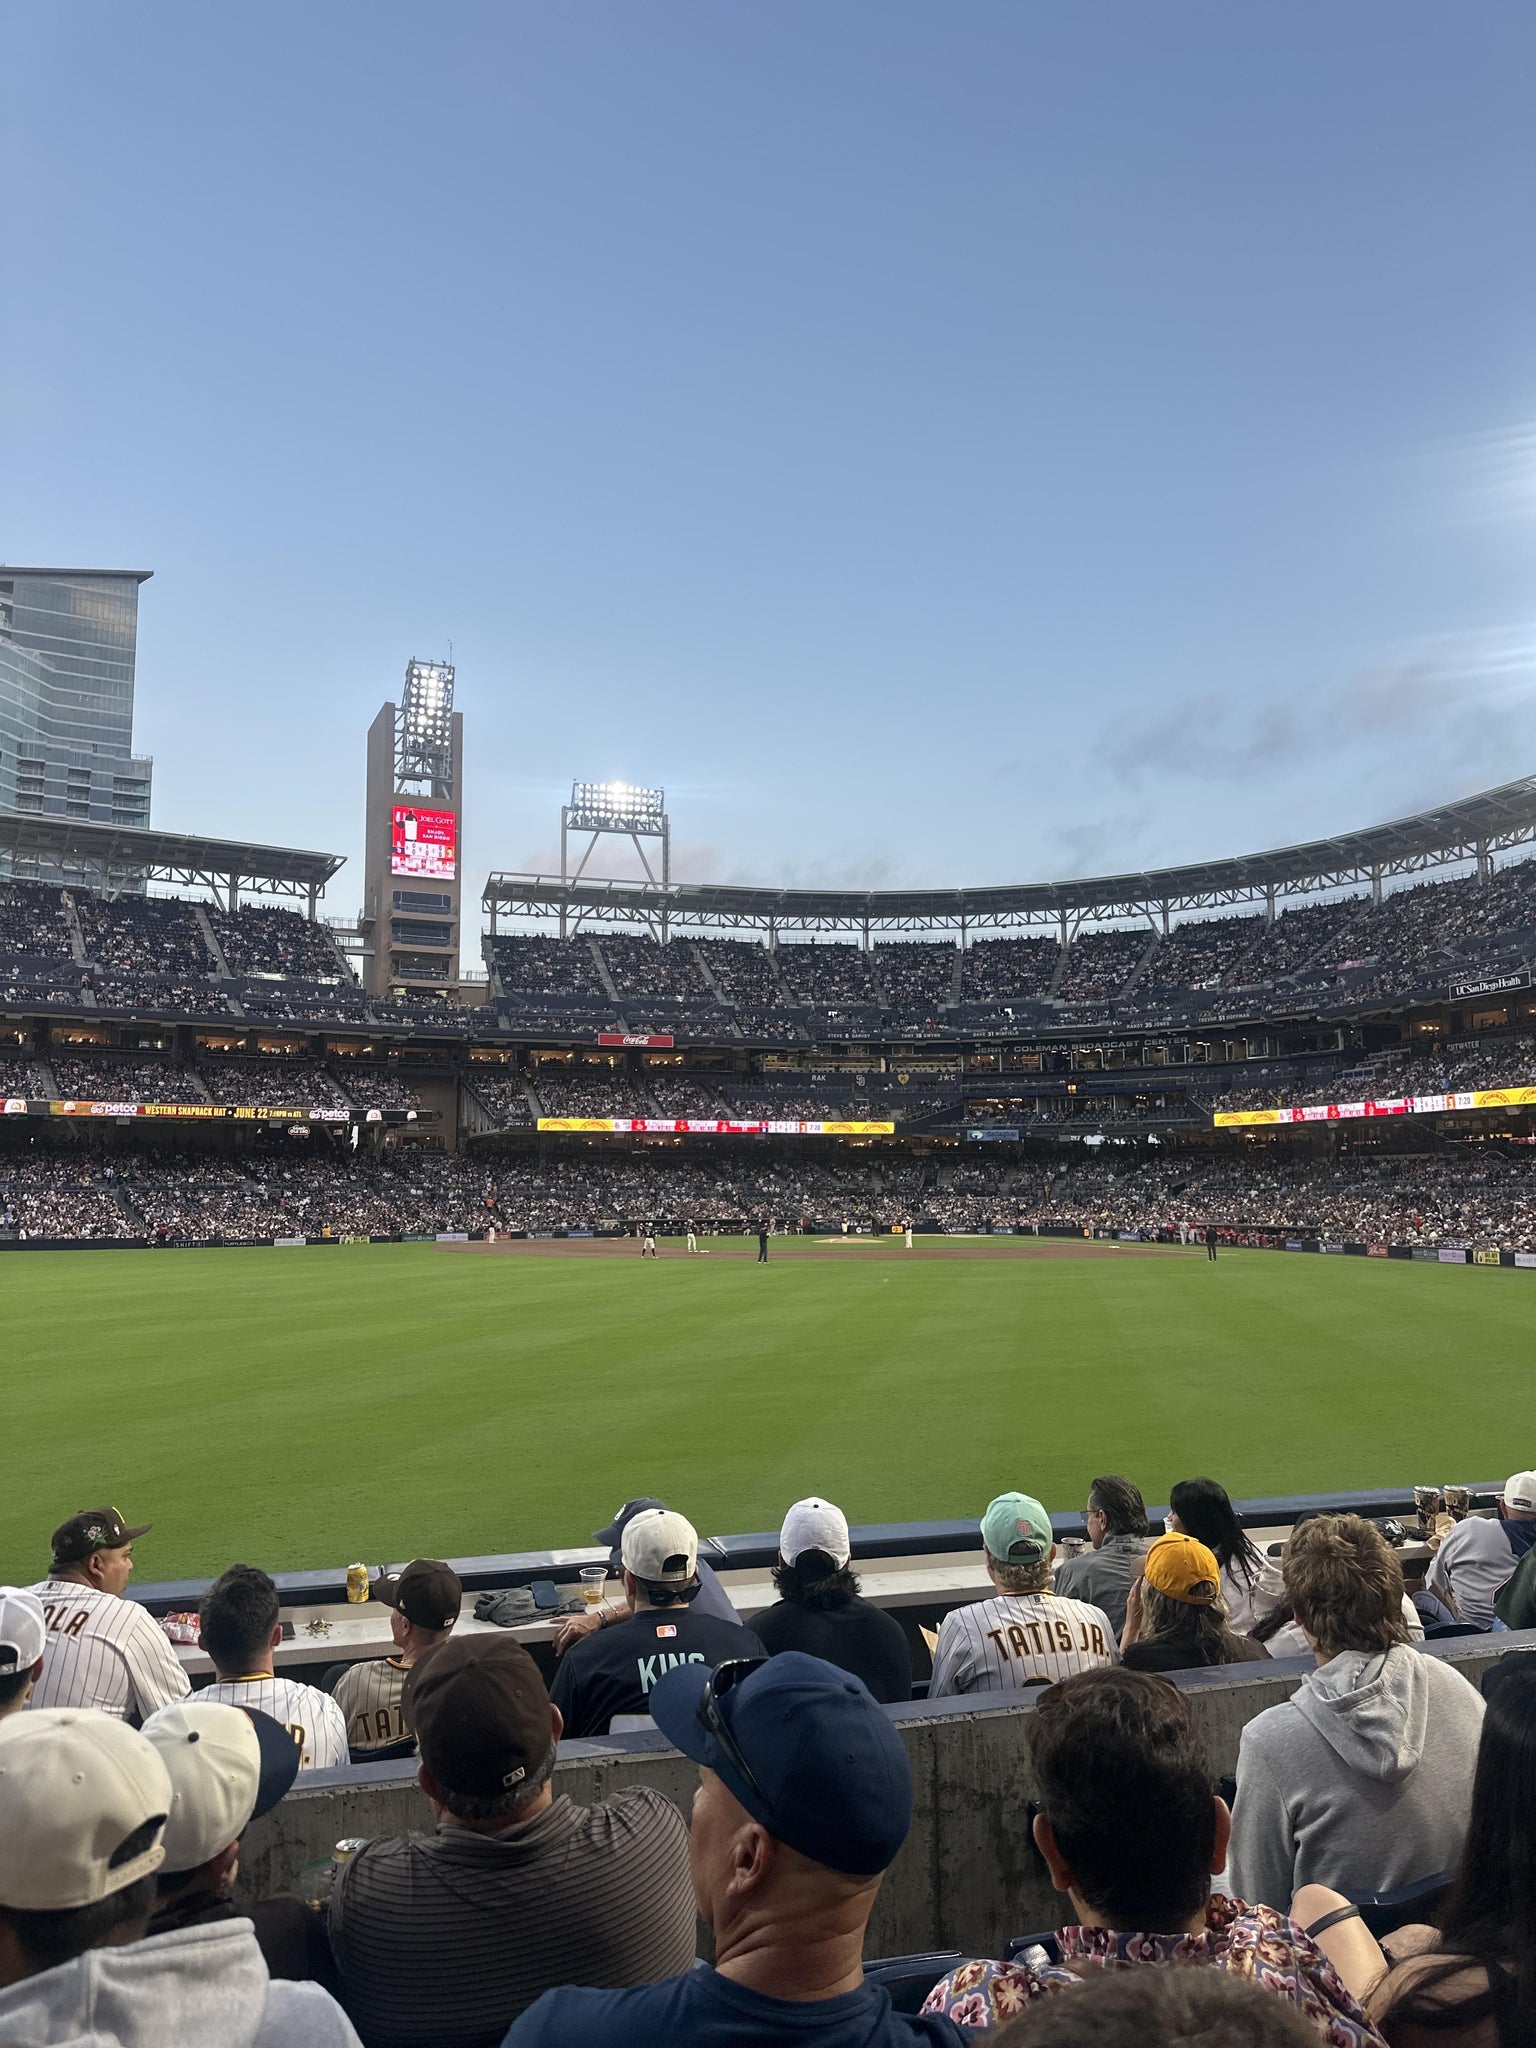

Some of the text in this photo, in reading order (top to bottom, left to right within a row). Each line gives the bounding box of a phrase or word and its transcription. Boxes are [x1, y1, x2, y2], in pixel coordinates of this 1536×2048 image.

[420, 815, 454, 825] JOEL GOTT
[1467, 984, 1480, 994] San
[1480, 982, 1499, 992] Diego
[1498, 976, 1521, 988] Health
[975, 1036, 1189, 1054] JERRY COLEMAN BROADCAST CENTER
[1458, 1096, 1471, 1105] 7:20
[105, 1102, 137, 1113] petco
[145, 1105, 177, 1115] WESTERN
[177, 1106, 212, 1116] SNAPBACK
[213, 1108, 227, 1117] HAT
[233, 1107, 255, 1119] JUNE
[256, 1107, 268, 1119] 22
[321, 1110, 350, 1120] petco
[987, 1621, 1110, 1661] TATIS JR.
